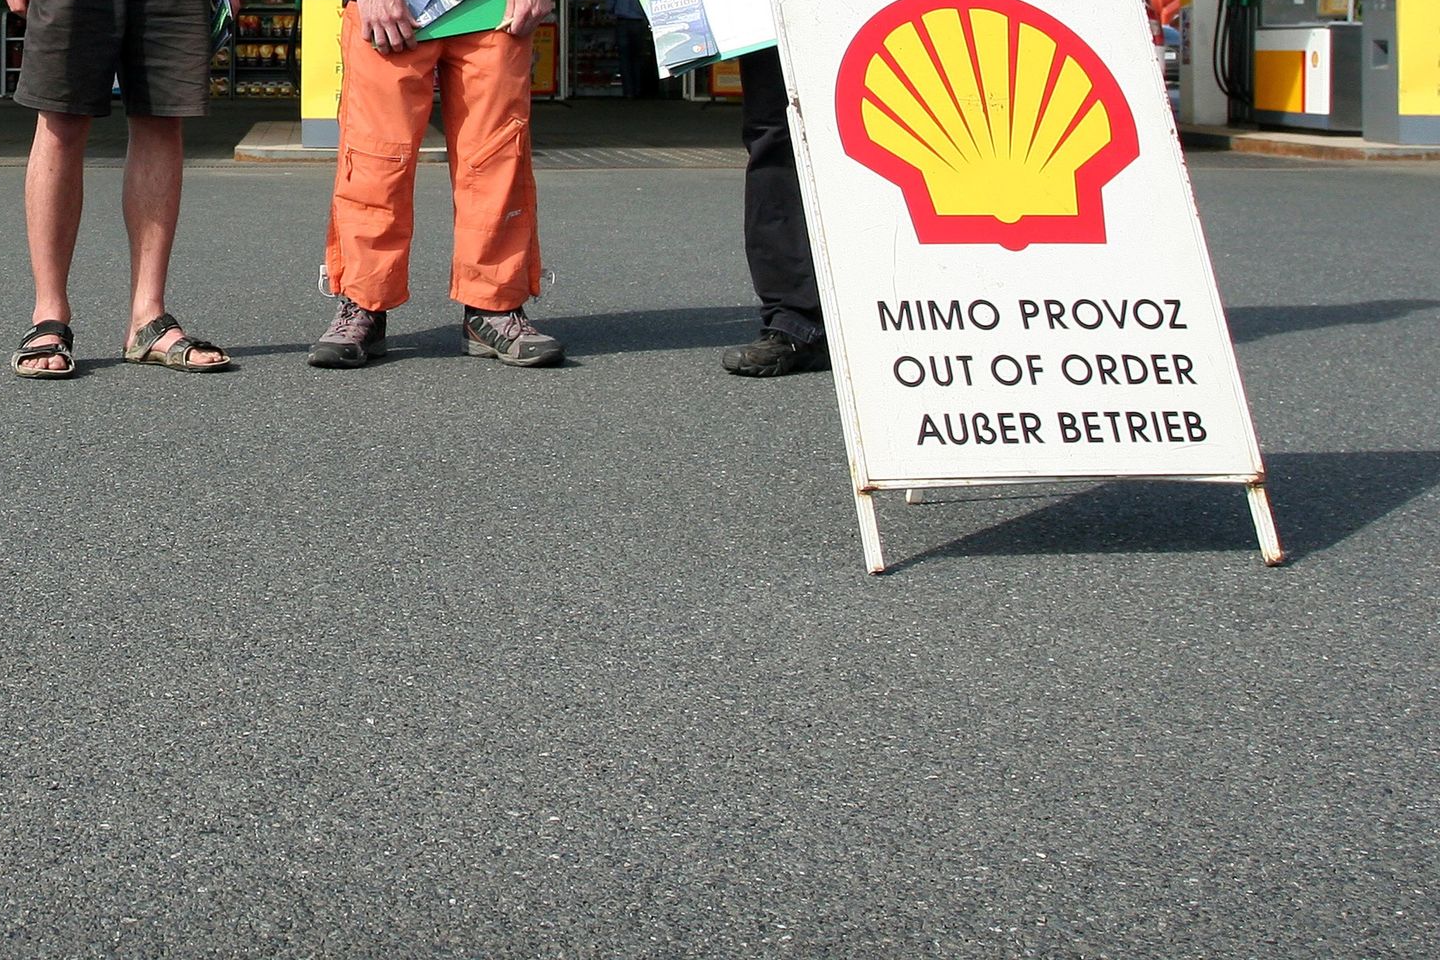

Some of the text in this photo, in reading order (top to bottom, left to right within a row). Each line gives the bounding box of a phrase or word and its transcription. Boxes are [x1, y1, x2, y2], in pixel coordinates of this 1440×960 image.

[877, 299, 1188, 331] MIMO PROVOZ
[893, 354, 1197, 388] OUT OF ORDER
[1057, 411, 1207, 442] BETRIEB
